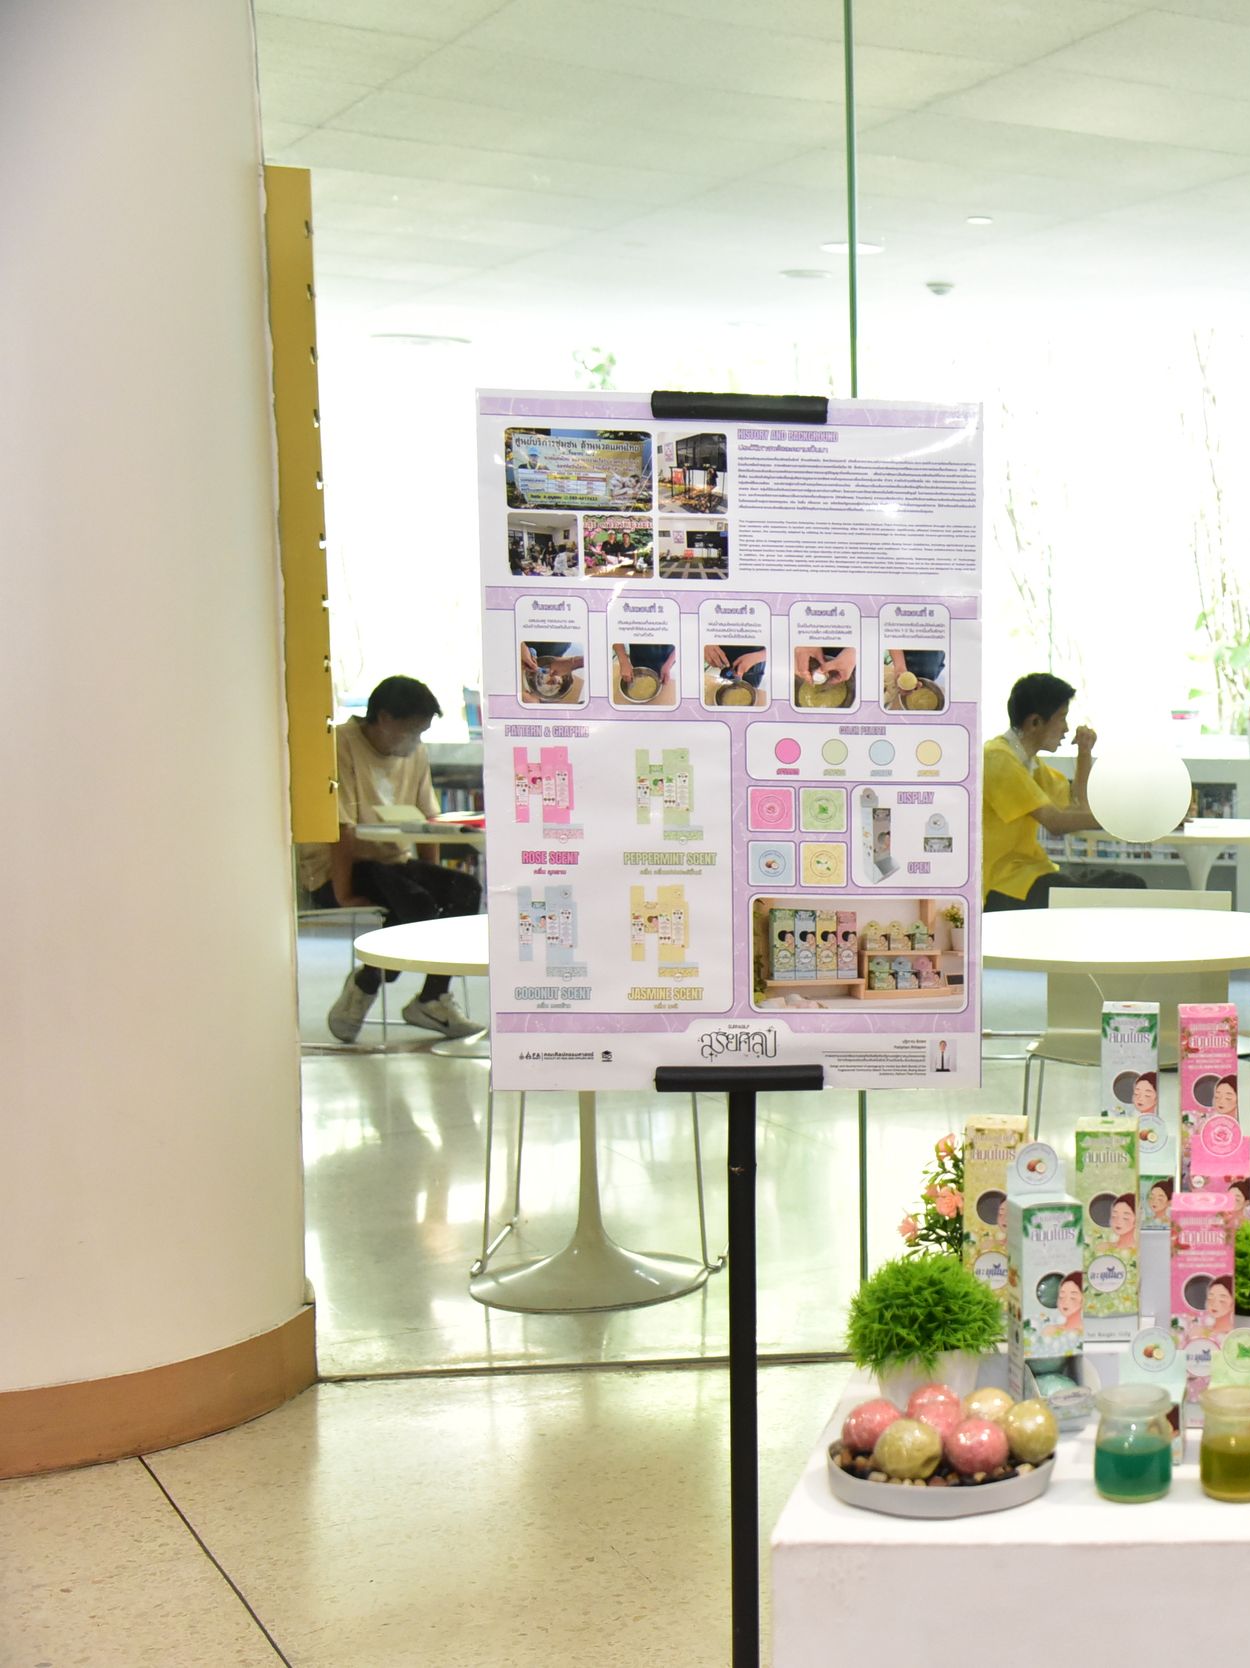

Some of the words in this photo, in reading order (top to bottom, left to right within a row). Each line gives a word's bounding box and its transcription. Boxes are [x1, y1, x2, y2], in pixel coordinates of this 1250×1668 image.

[737, 429, 769, 440] HISTORY
[770, 430, 787, 441] AND
[788, 431, 839, 442] BACKGROUND
[505, 724, 541, 738] PATTERN
[553, 725, 589, 738] GRAPHIC
[897, 791, 934, 804] DISPLAY
[521, 851, 547, 865] ROSE
[549, 851, 579, 865] SCENT
[624, 852, 685, 865] PEPPERMINT
[687, 852, 717, 865] SCENT
[907, 861, 930, 874] OPEN
[515, 987, 560, 1000] COCONUT
[561, 987, 592, 1000] SCENT
[628, 987, 674, 1000] JASMINE
[675, 987, 704, 1000] SCENT
